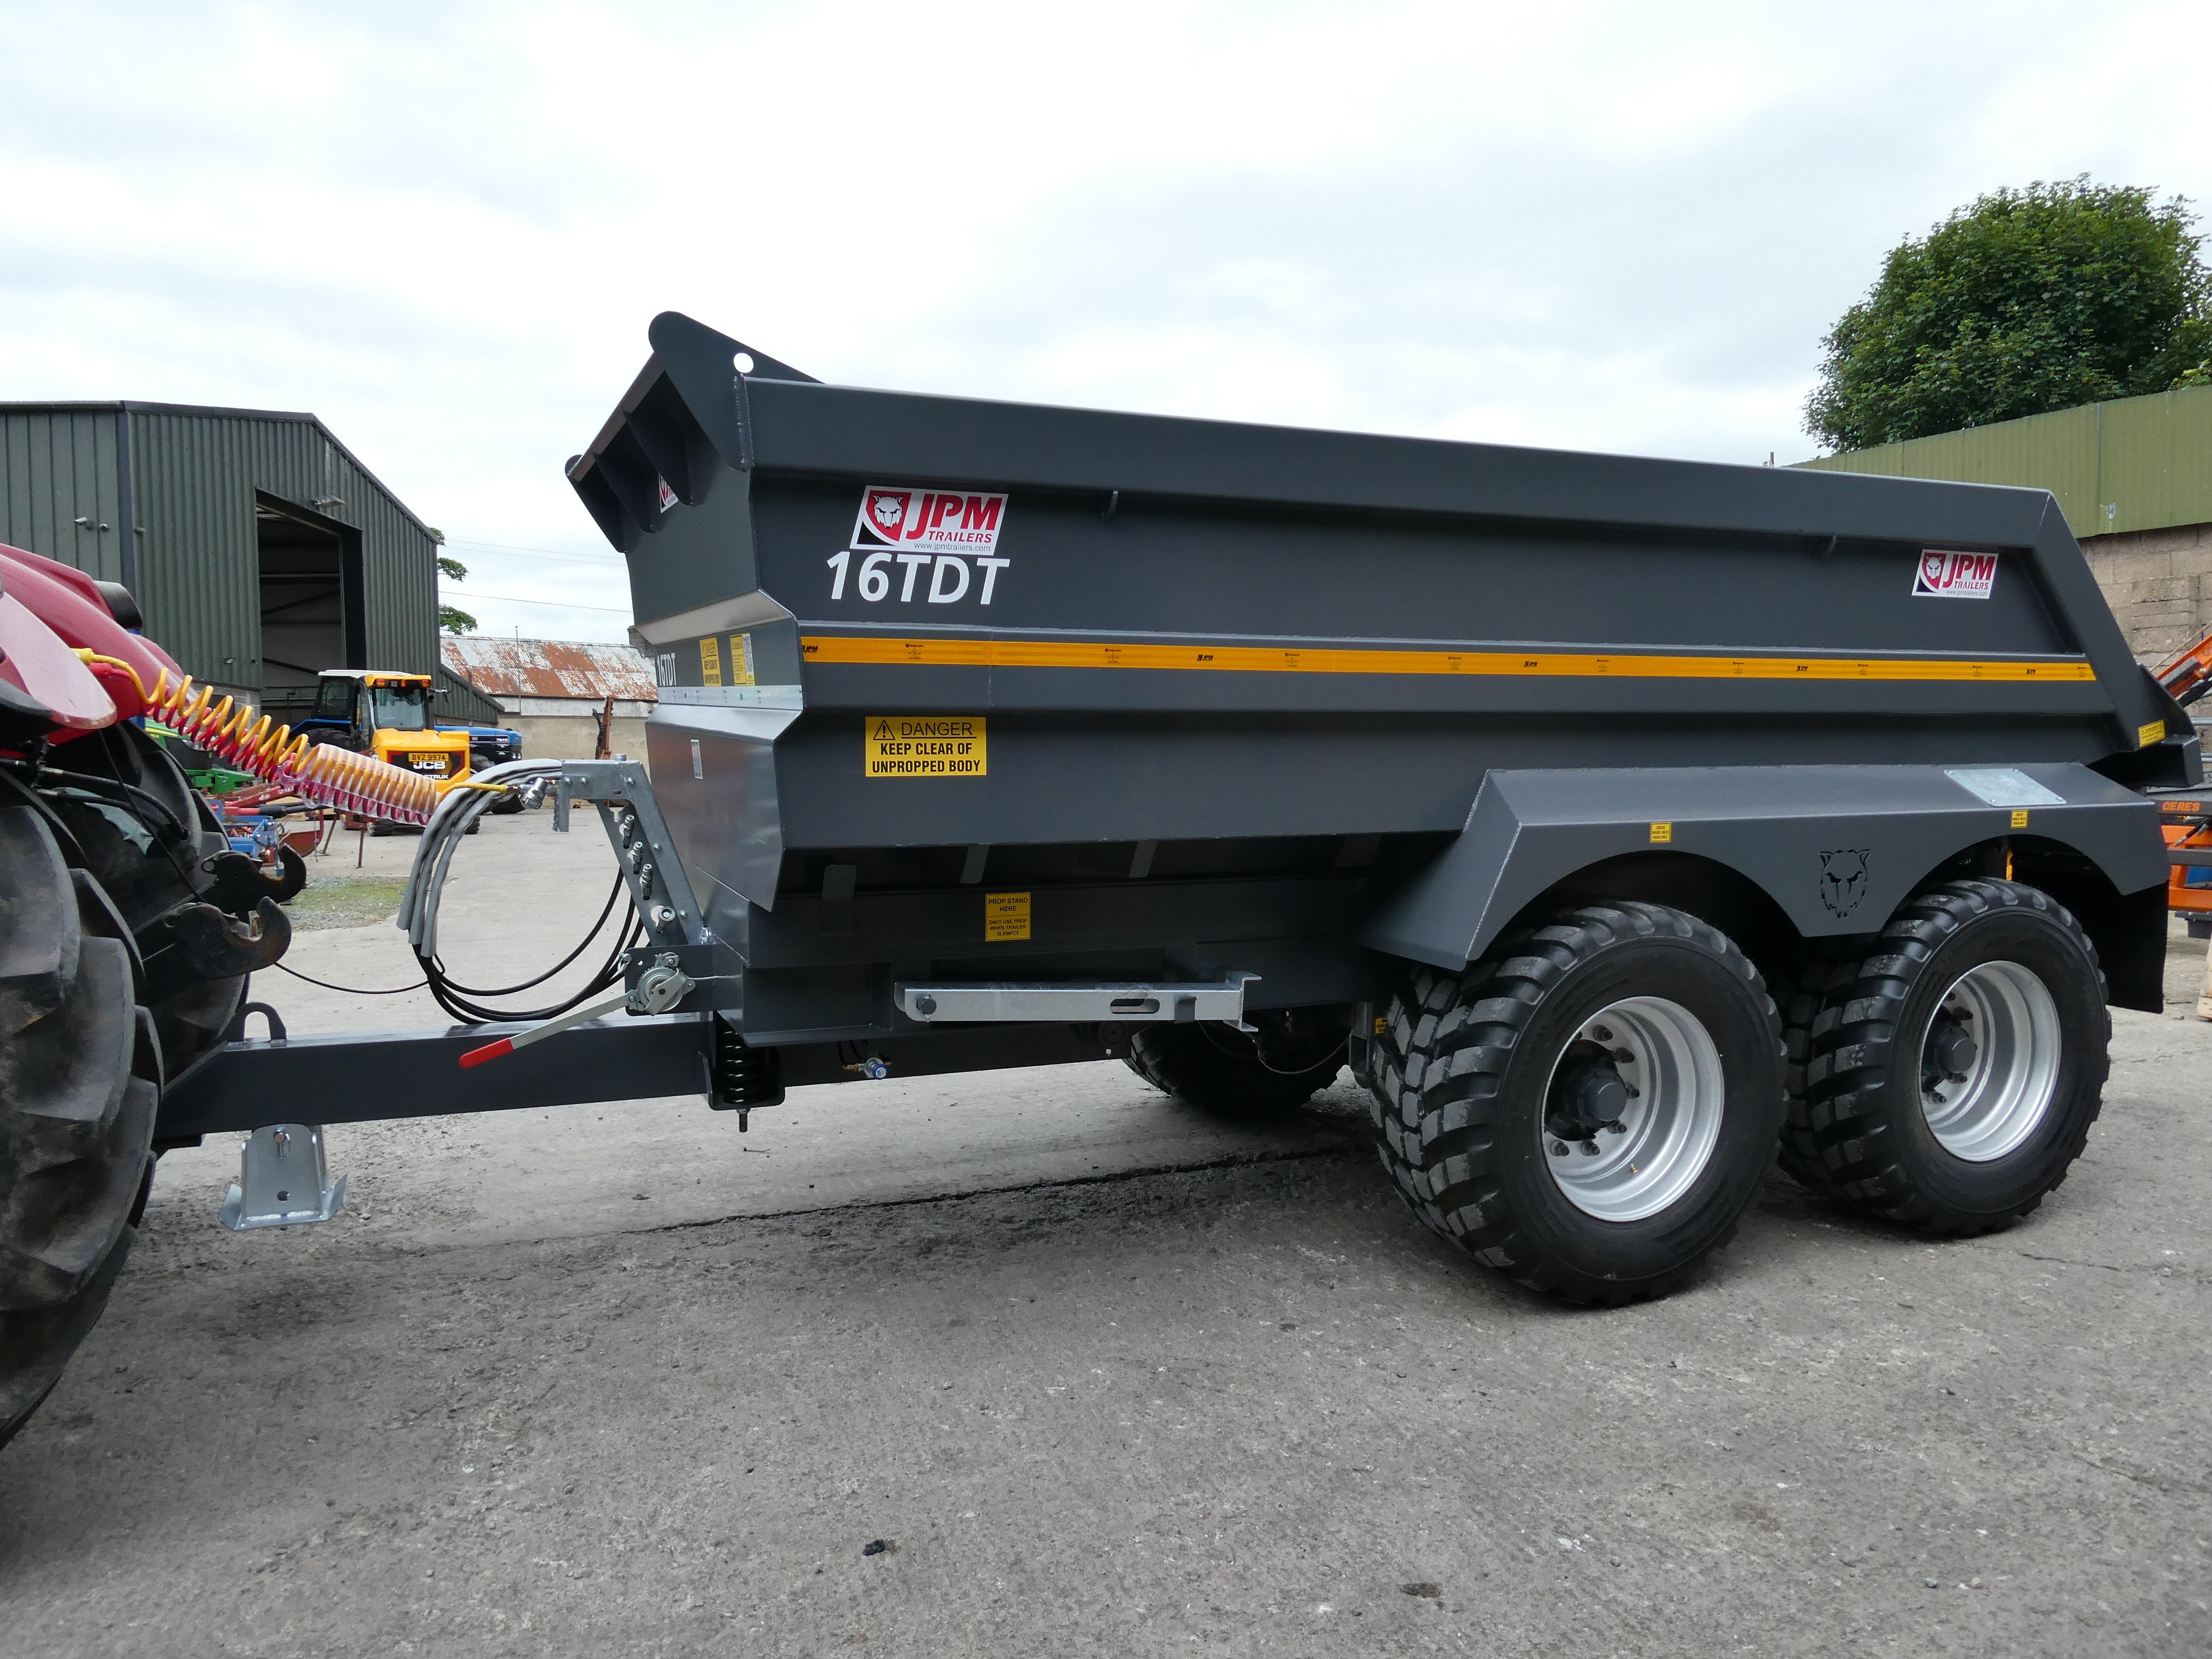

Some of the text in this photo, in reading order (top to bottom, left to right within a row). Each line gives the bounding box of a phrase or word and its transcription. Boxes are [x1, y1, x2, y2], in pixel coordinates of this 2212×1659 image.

[905, 493, 1002, 540] JPM
[928, 531, 992, 543] TRAILERS
[914, 542, 991, 552] www.jpmtrailers.com
[1942, 553, 1995, 588] JPM
[827, 551, 1010, 605] 16TDT
[1954, 581, 1989, 590] TRAILERS
[657, 652, 676, 686] 16TDT
[902, 722, 973, 736] DANGER
[880, 742, 972, 755] KEEP CLEAR OF
[872, 760, 981, 773] UNPROPPED BODY
